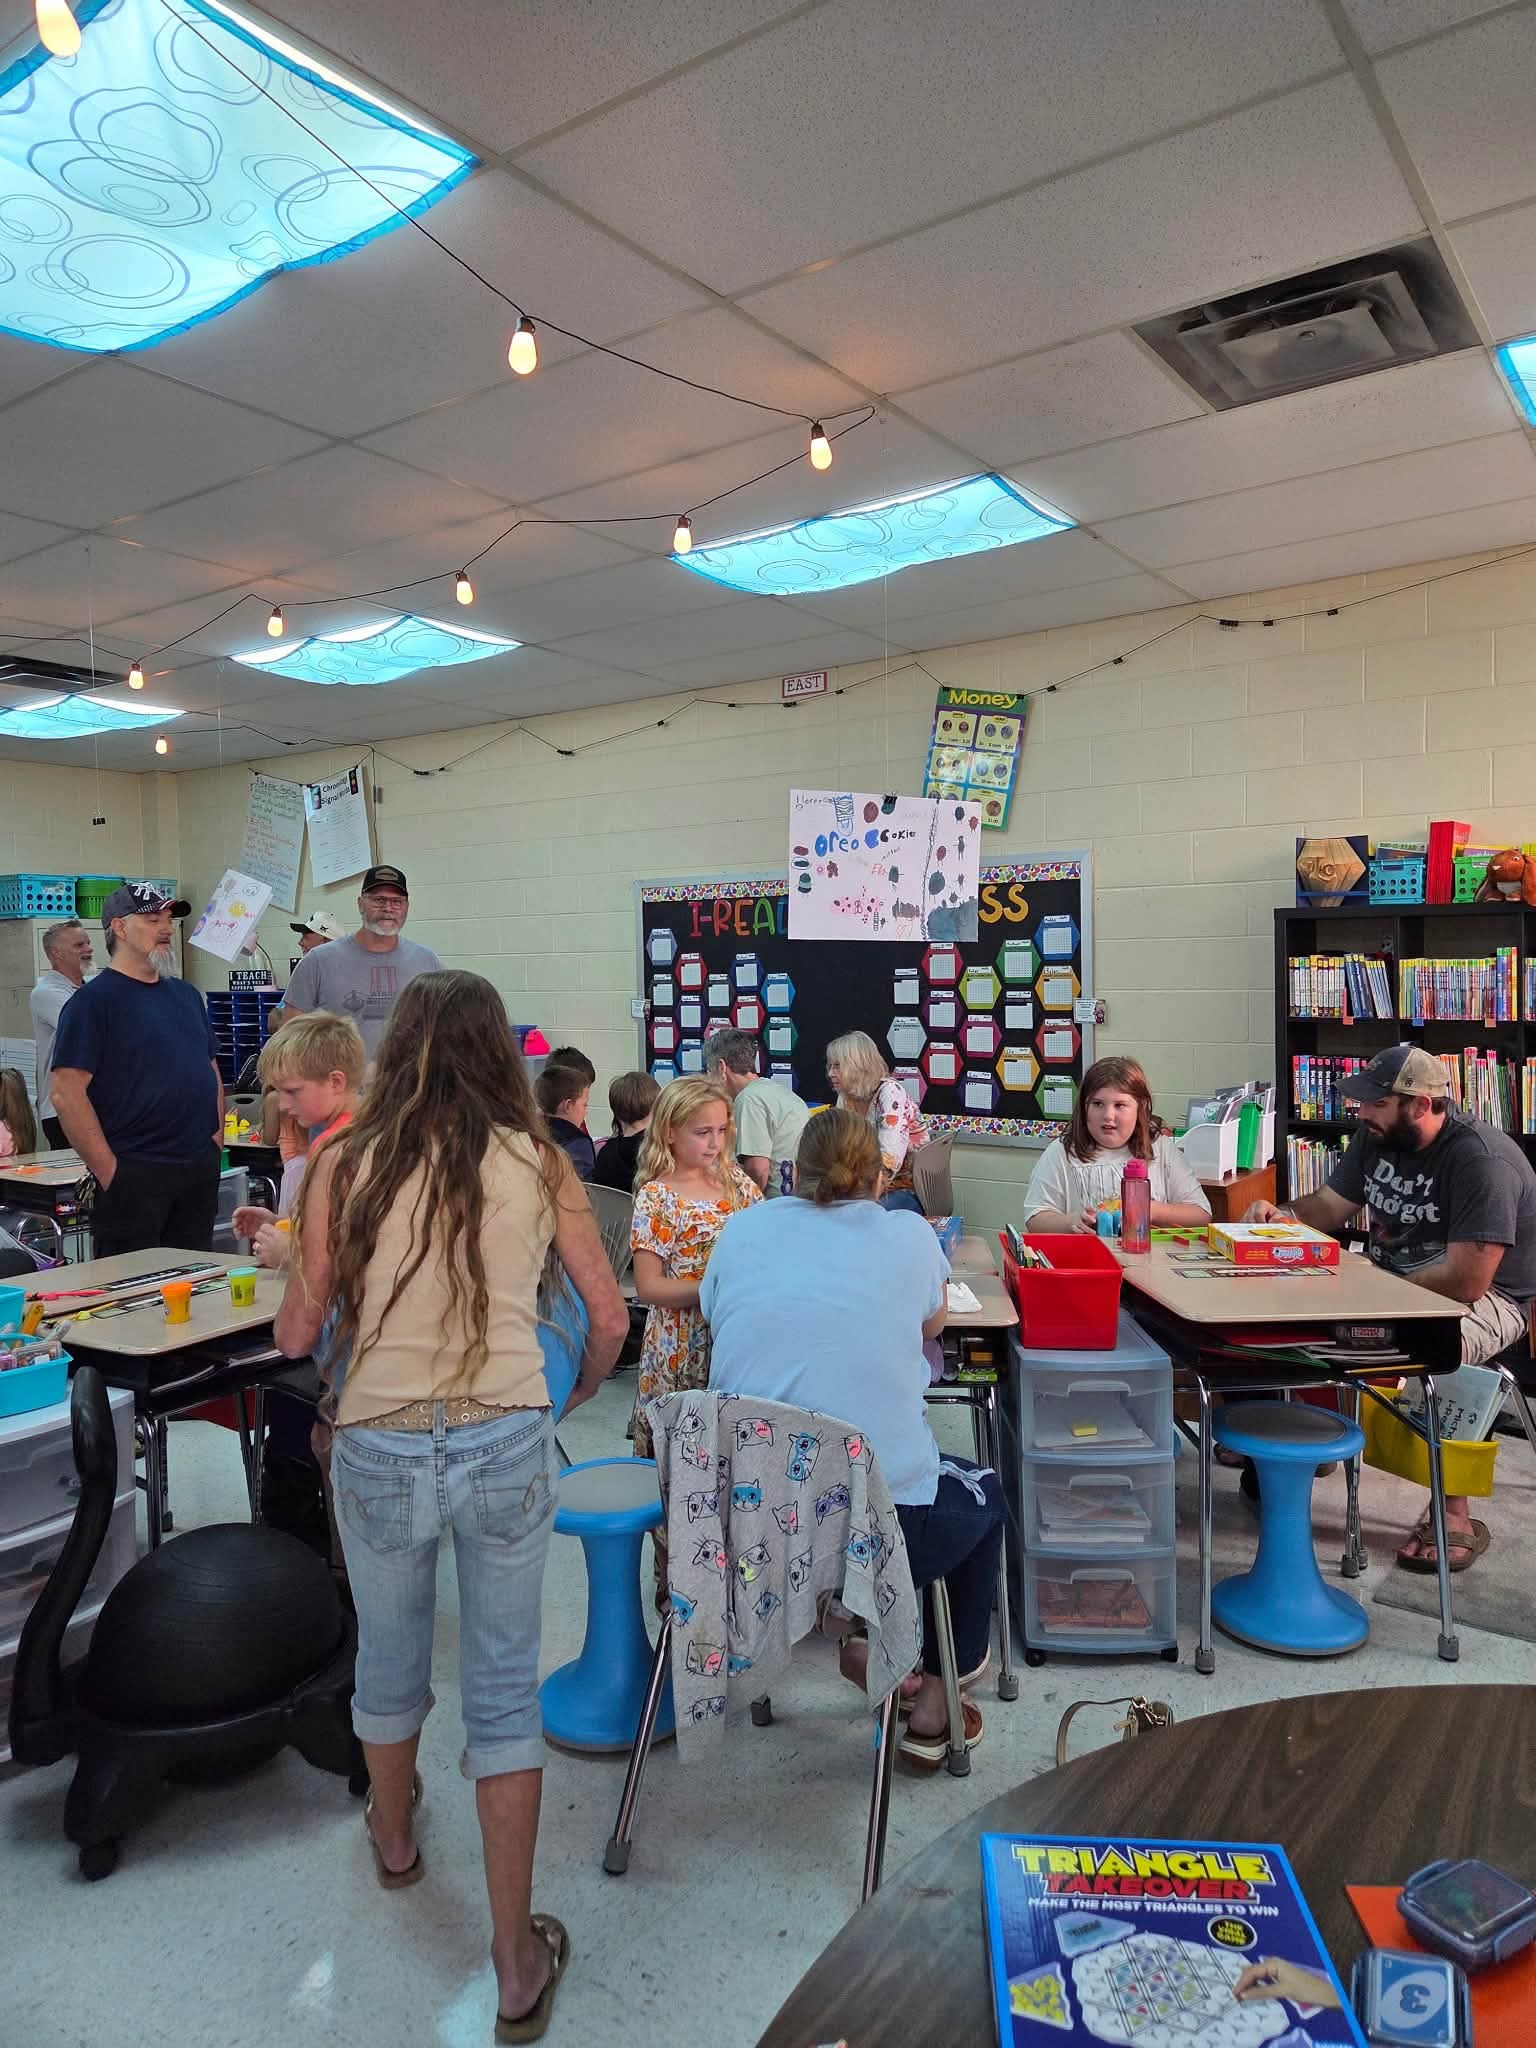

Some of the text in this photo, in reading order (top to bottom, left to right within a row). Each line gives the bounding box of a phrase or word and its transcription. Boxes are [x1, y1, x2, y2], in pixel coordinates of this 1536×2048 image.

[787, 675, 822, 692] EAST
[948, 688, 1018, 709] Money
[236, 970, 267, 980] TEACH
[1013, 1846, 1273, 1883] TRIANGLE
[1043, 1871, 1250, 1899] TAKEOVER
[1028, 1897, 1279, 1917] MAKE THE MOST TRIANGLES TO WIN
